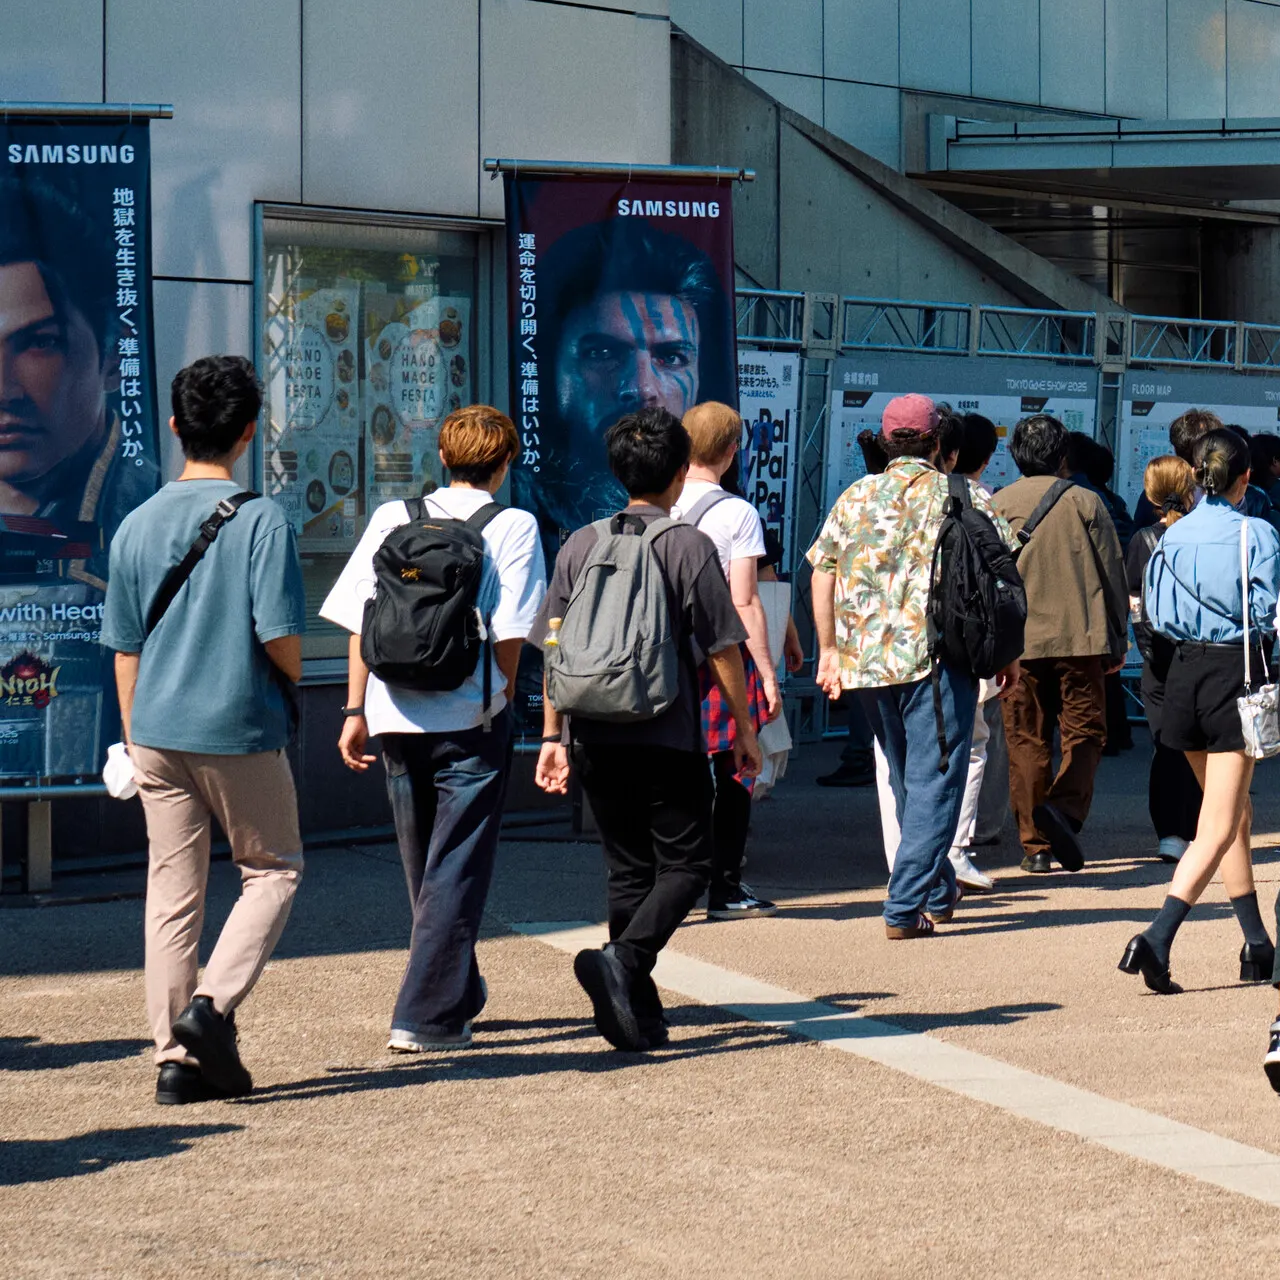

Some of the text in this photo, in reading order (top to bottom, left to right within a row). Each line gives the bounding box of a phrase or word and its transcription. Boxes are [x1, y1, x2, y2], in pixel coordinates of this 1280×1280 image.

[8, 144, 135, 164] SAMSUNG
[618, 199, 720, 218] SAMSUNG
[112, 187, 144, 467] 地獄を生き抜く、準備はいいか。
[518, 233, 541, 473] 運命を切り開く、準備はいいか。
[1132, 384, 1172, 396] FLOOR MAP
[0, 603, 46, 622] with
[43, 631, 91, 642] Samsung
[527, 695, 544, 703] TOK
